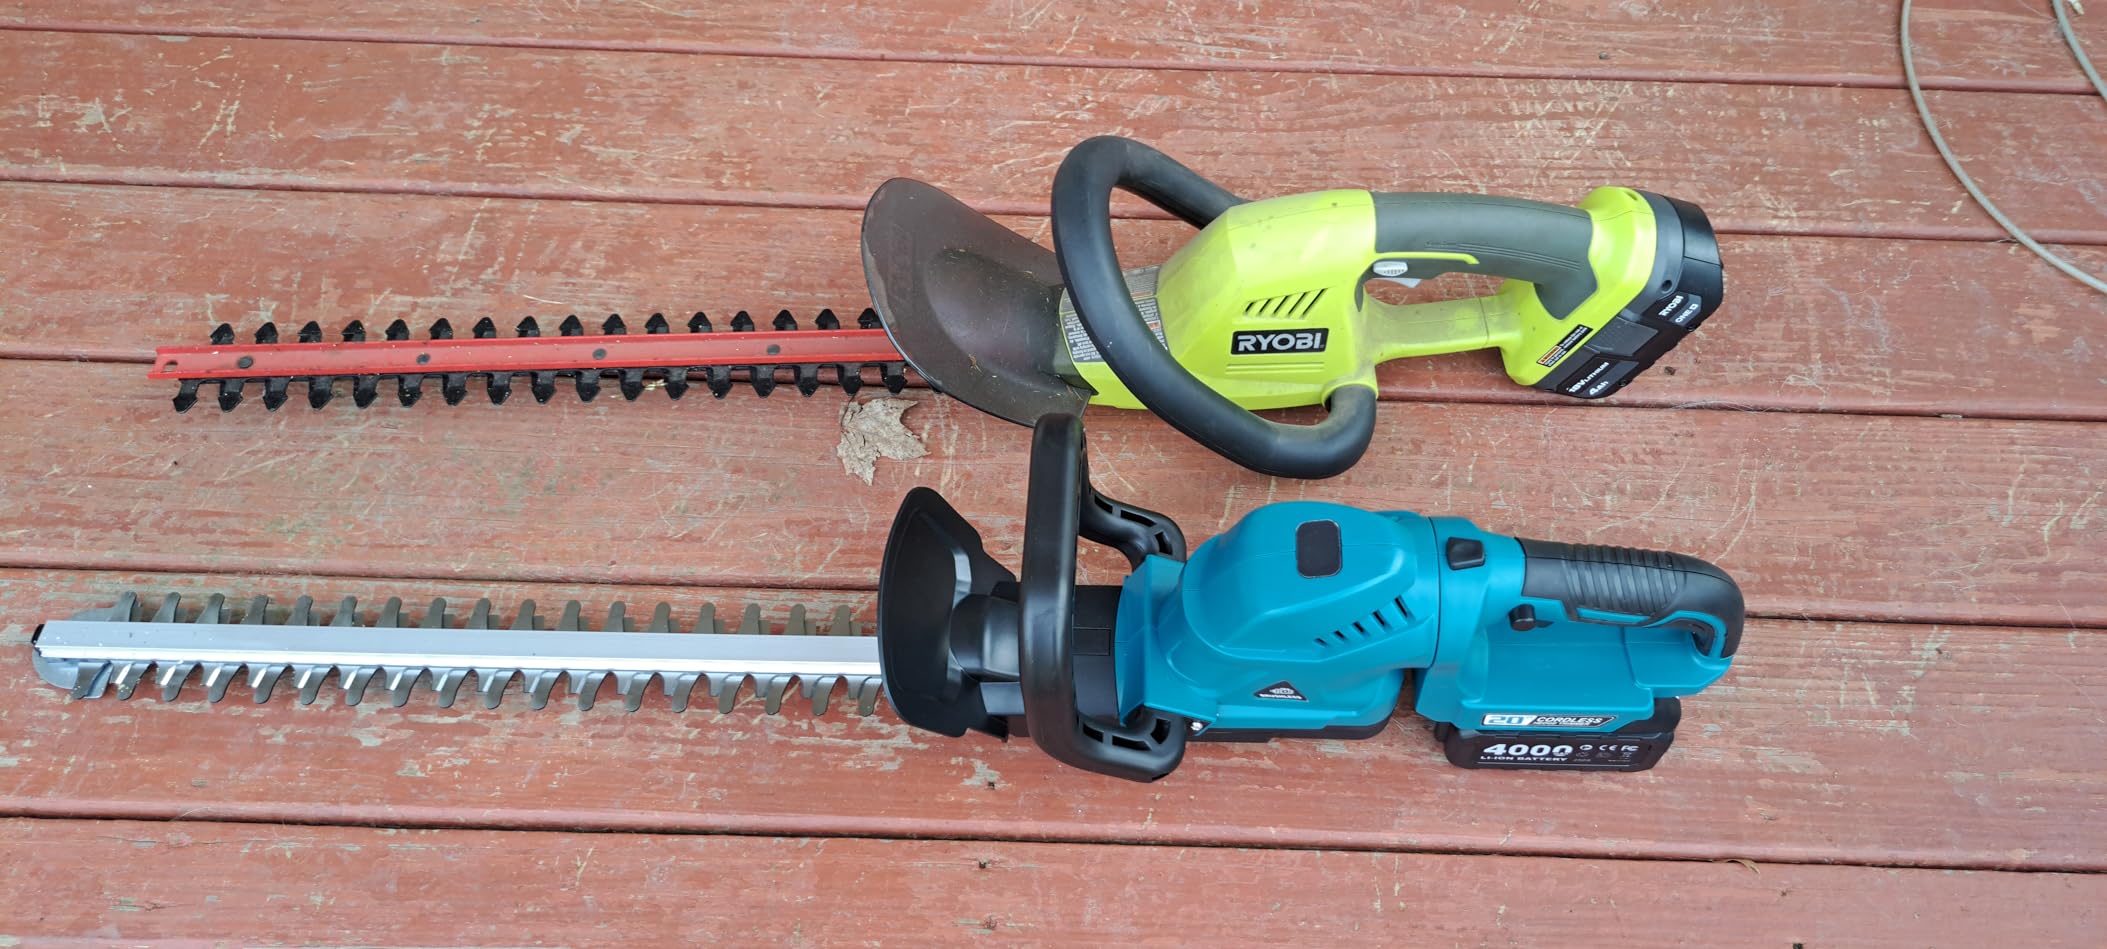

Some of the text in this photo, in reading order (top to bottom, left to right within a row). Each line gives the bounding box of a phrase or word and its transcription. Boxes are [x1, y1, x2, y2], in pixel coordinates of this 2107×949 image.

[1658, 295, 1684, 316] RYOBI
[1237, 333, 1322, 351] RYOBI
[1535, 716, 1603, 724] CORDLESS
[1483, 744, 1573, 756] 4000
